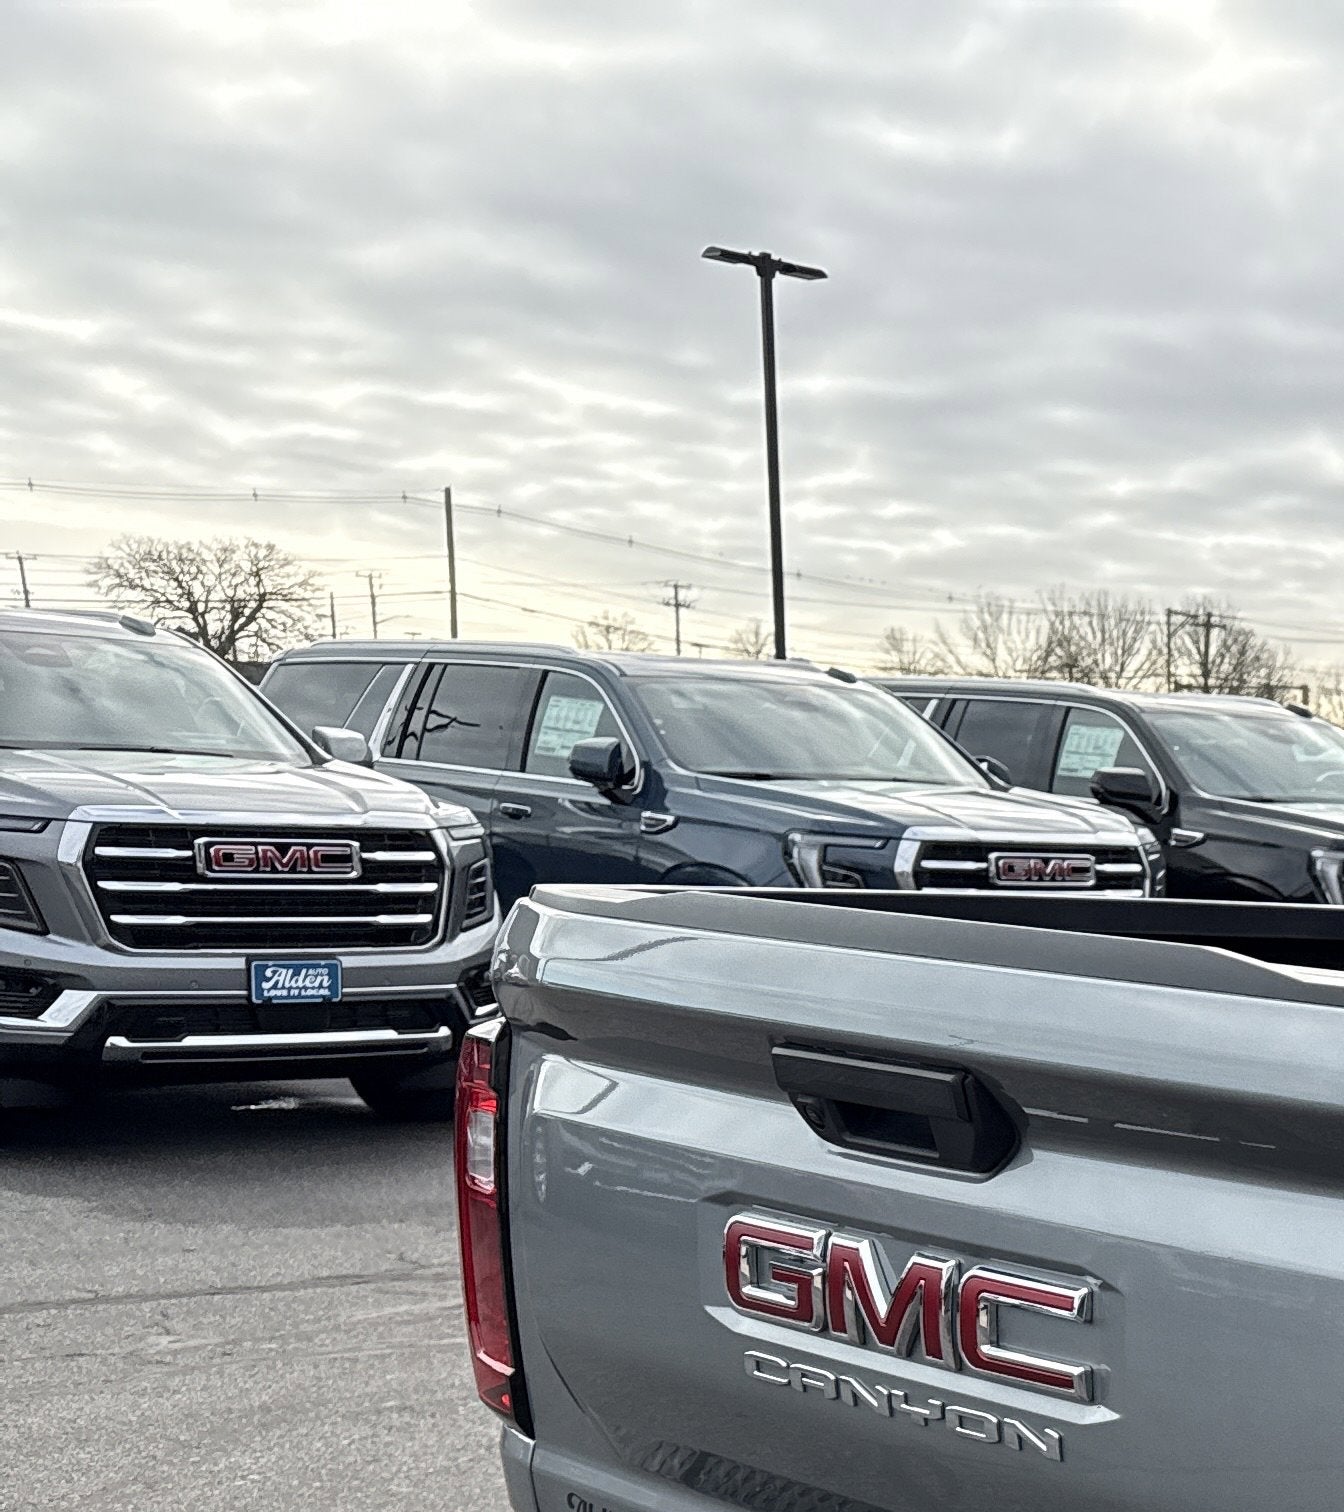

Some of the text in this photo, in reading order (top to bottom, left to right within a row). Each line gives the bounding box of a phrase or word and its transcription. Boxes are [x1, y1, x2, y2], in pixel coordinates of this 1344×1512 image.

[210, 845, 353, 872] GMC
[998, 858, 1091, 880] GMC
[261, 966, 332, 989] Alden
[263, 989, 288, 997] LOVE
[301, 988, 331, 996] LOCAL
[723, 1211, 1095, 1403] GMC
[743, 1350, 1064, 1462] CANYON
